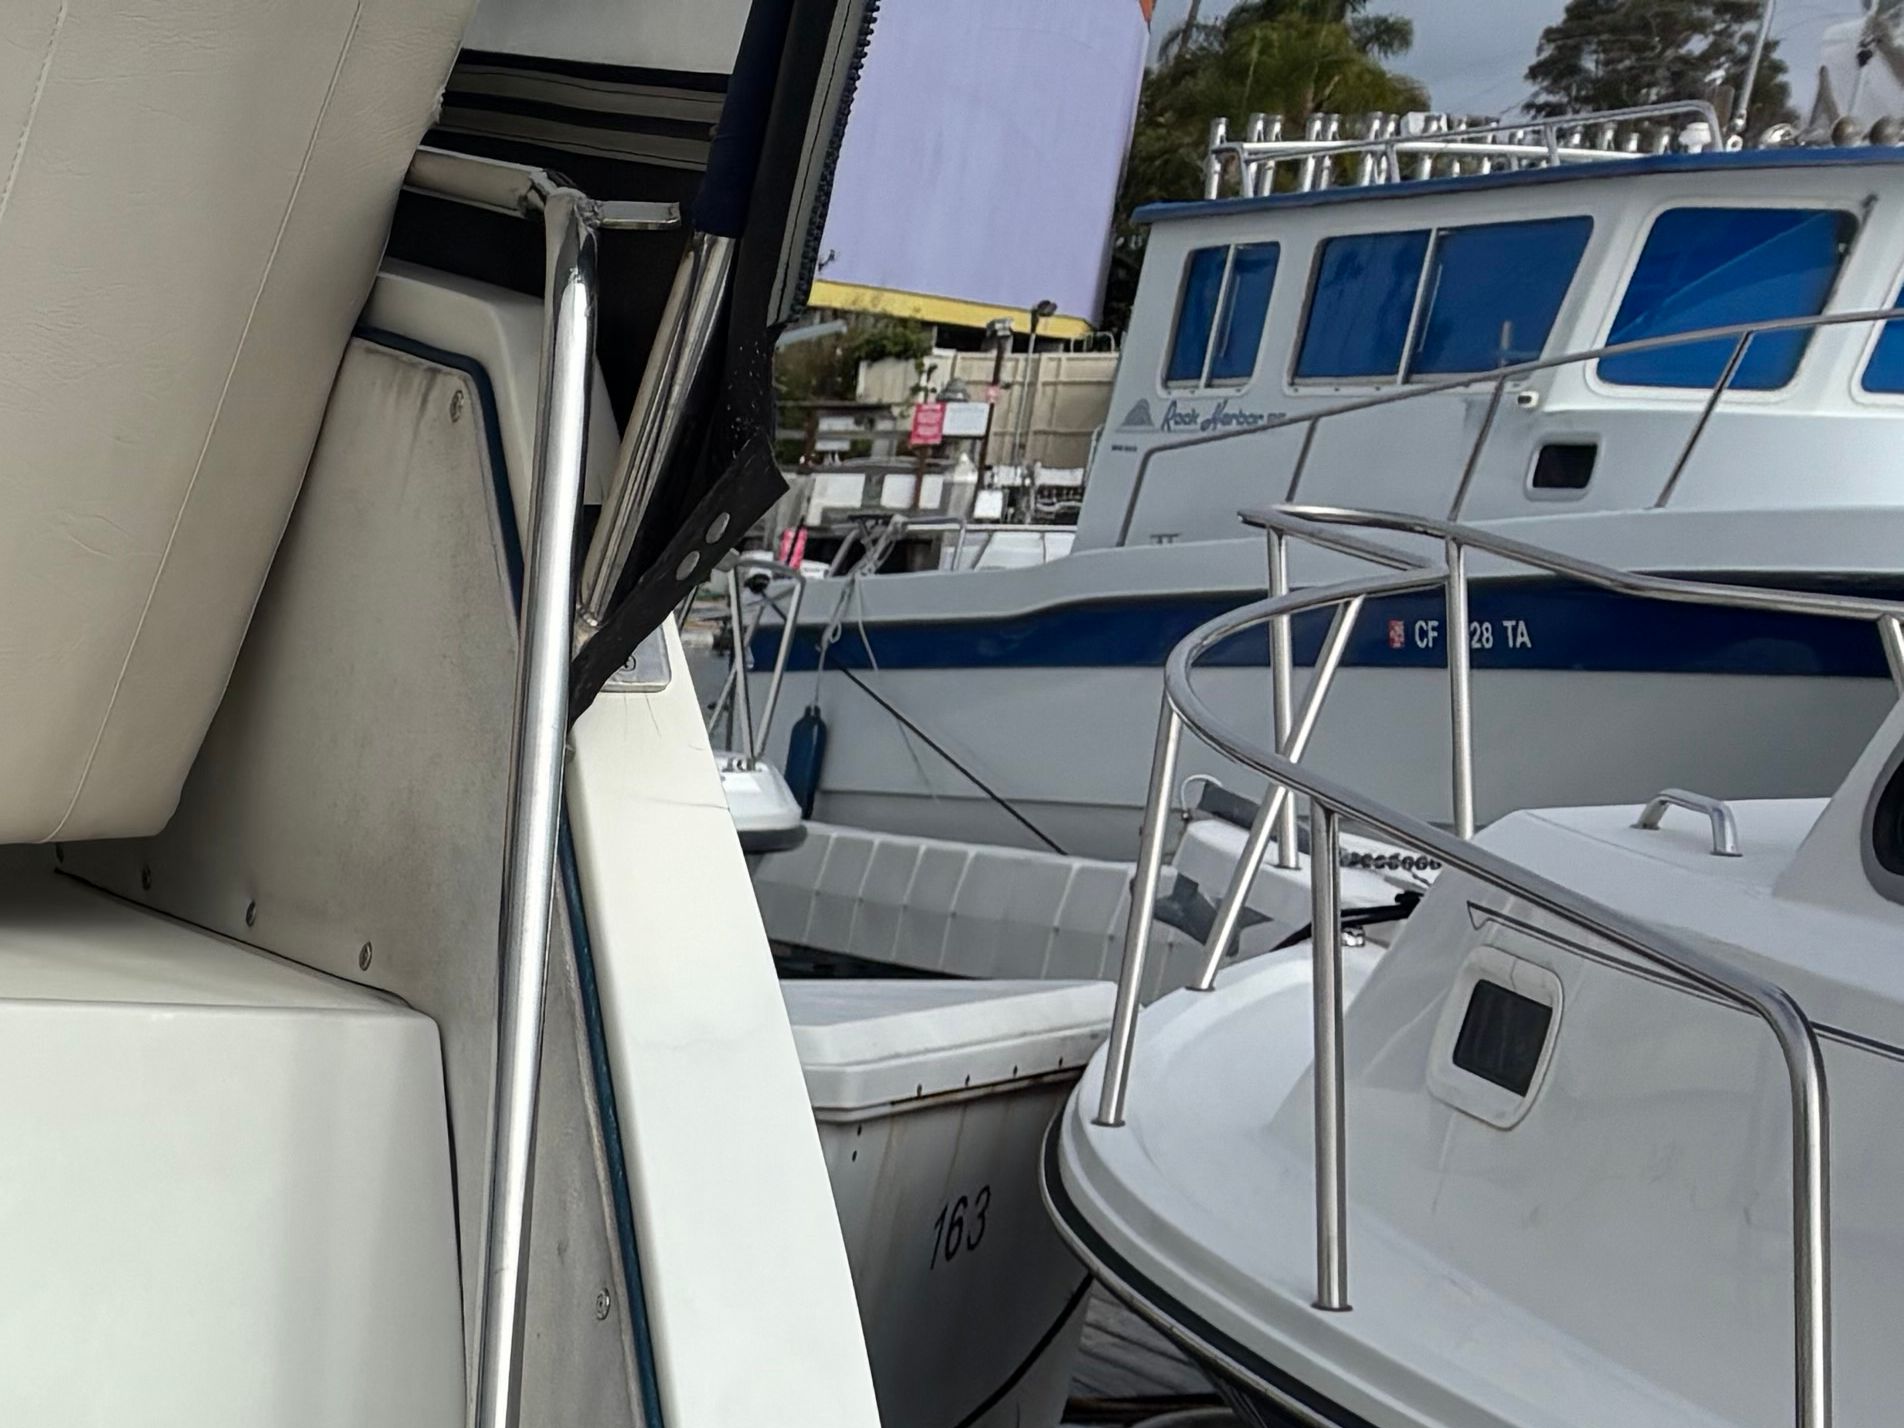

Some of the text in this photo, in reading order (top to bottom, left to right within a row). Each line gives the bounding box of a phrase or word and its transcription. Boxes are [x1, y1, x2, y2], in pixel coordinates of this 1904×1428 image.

[1414, 620, 1439, 648] CF
[1469, 621, 1494, 649] 28
[1502, 620, 1532, 648] TA
[930, 1184, 991, 1271] 163
